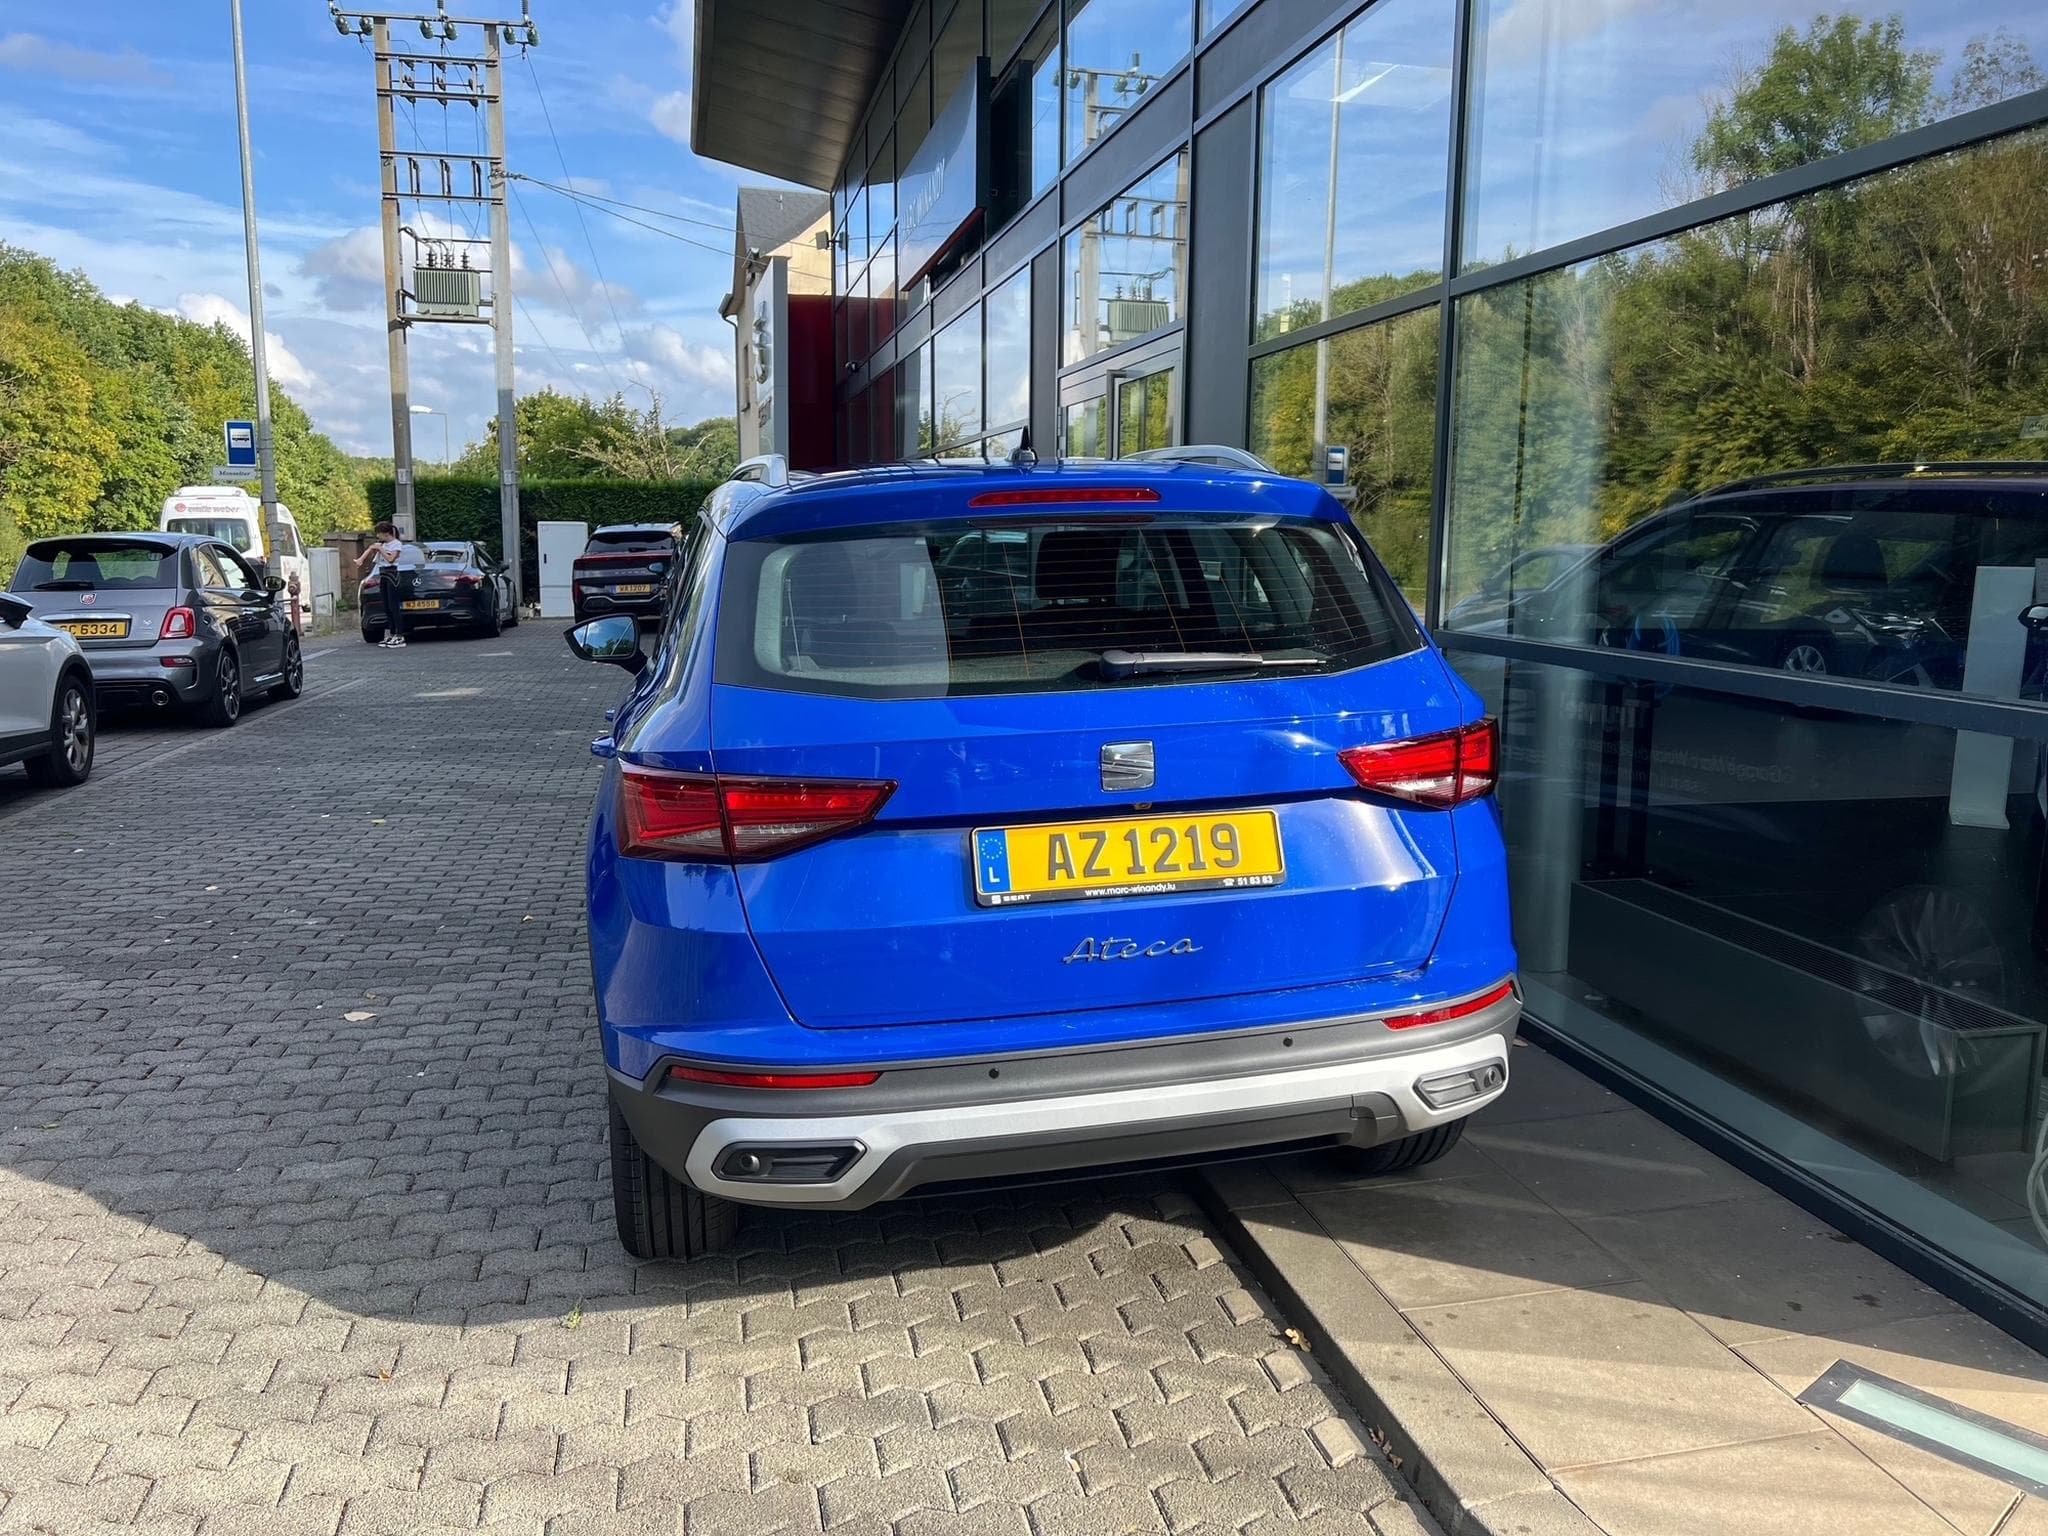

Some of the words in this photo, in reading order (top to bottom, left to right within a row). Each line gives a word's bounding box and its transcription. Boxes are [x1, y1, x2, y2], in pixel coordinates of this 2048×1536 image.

[80, 624, 118, 635] 6334
[1047, 830, 1113, 881] AZ
[1123, 822, 1242, 875] 1219
[988, 866, 1000, 883] L
[1237, 876, 1248, 886] 51
[1085, 883, 1176, 896] www.marc-winandy.lu
[1062, 937, 1203, 964] Ateca
